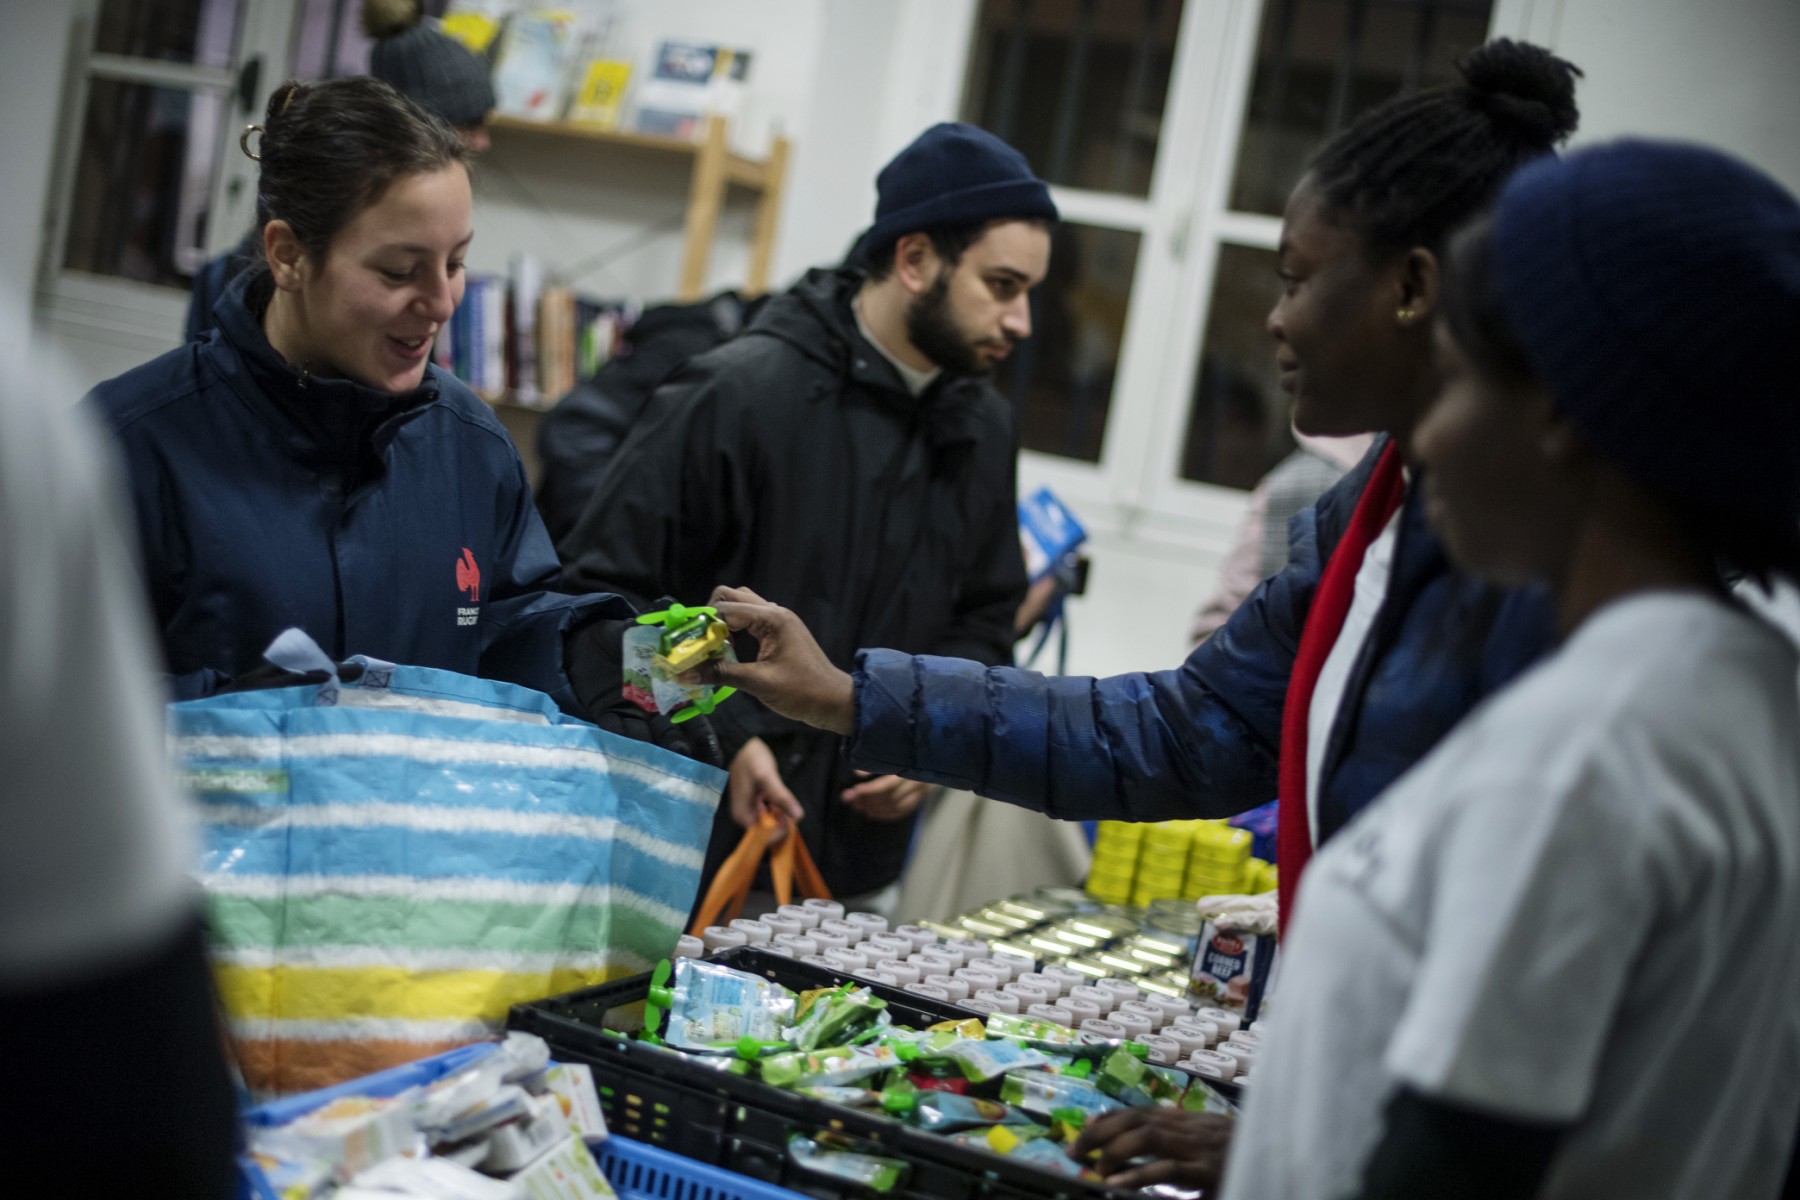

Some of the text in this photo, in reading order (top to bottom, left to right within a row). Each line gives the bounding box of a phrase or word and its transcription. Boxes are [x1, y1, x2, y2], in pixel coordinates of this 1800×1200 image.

[457, 607, 480, 616] FRANC
[457, 616, 478, 626] RUG
[1212, 962, 1233, 979] BEEF
